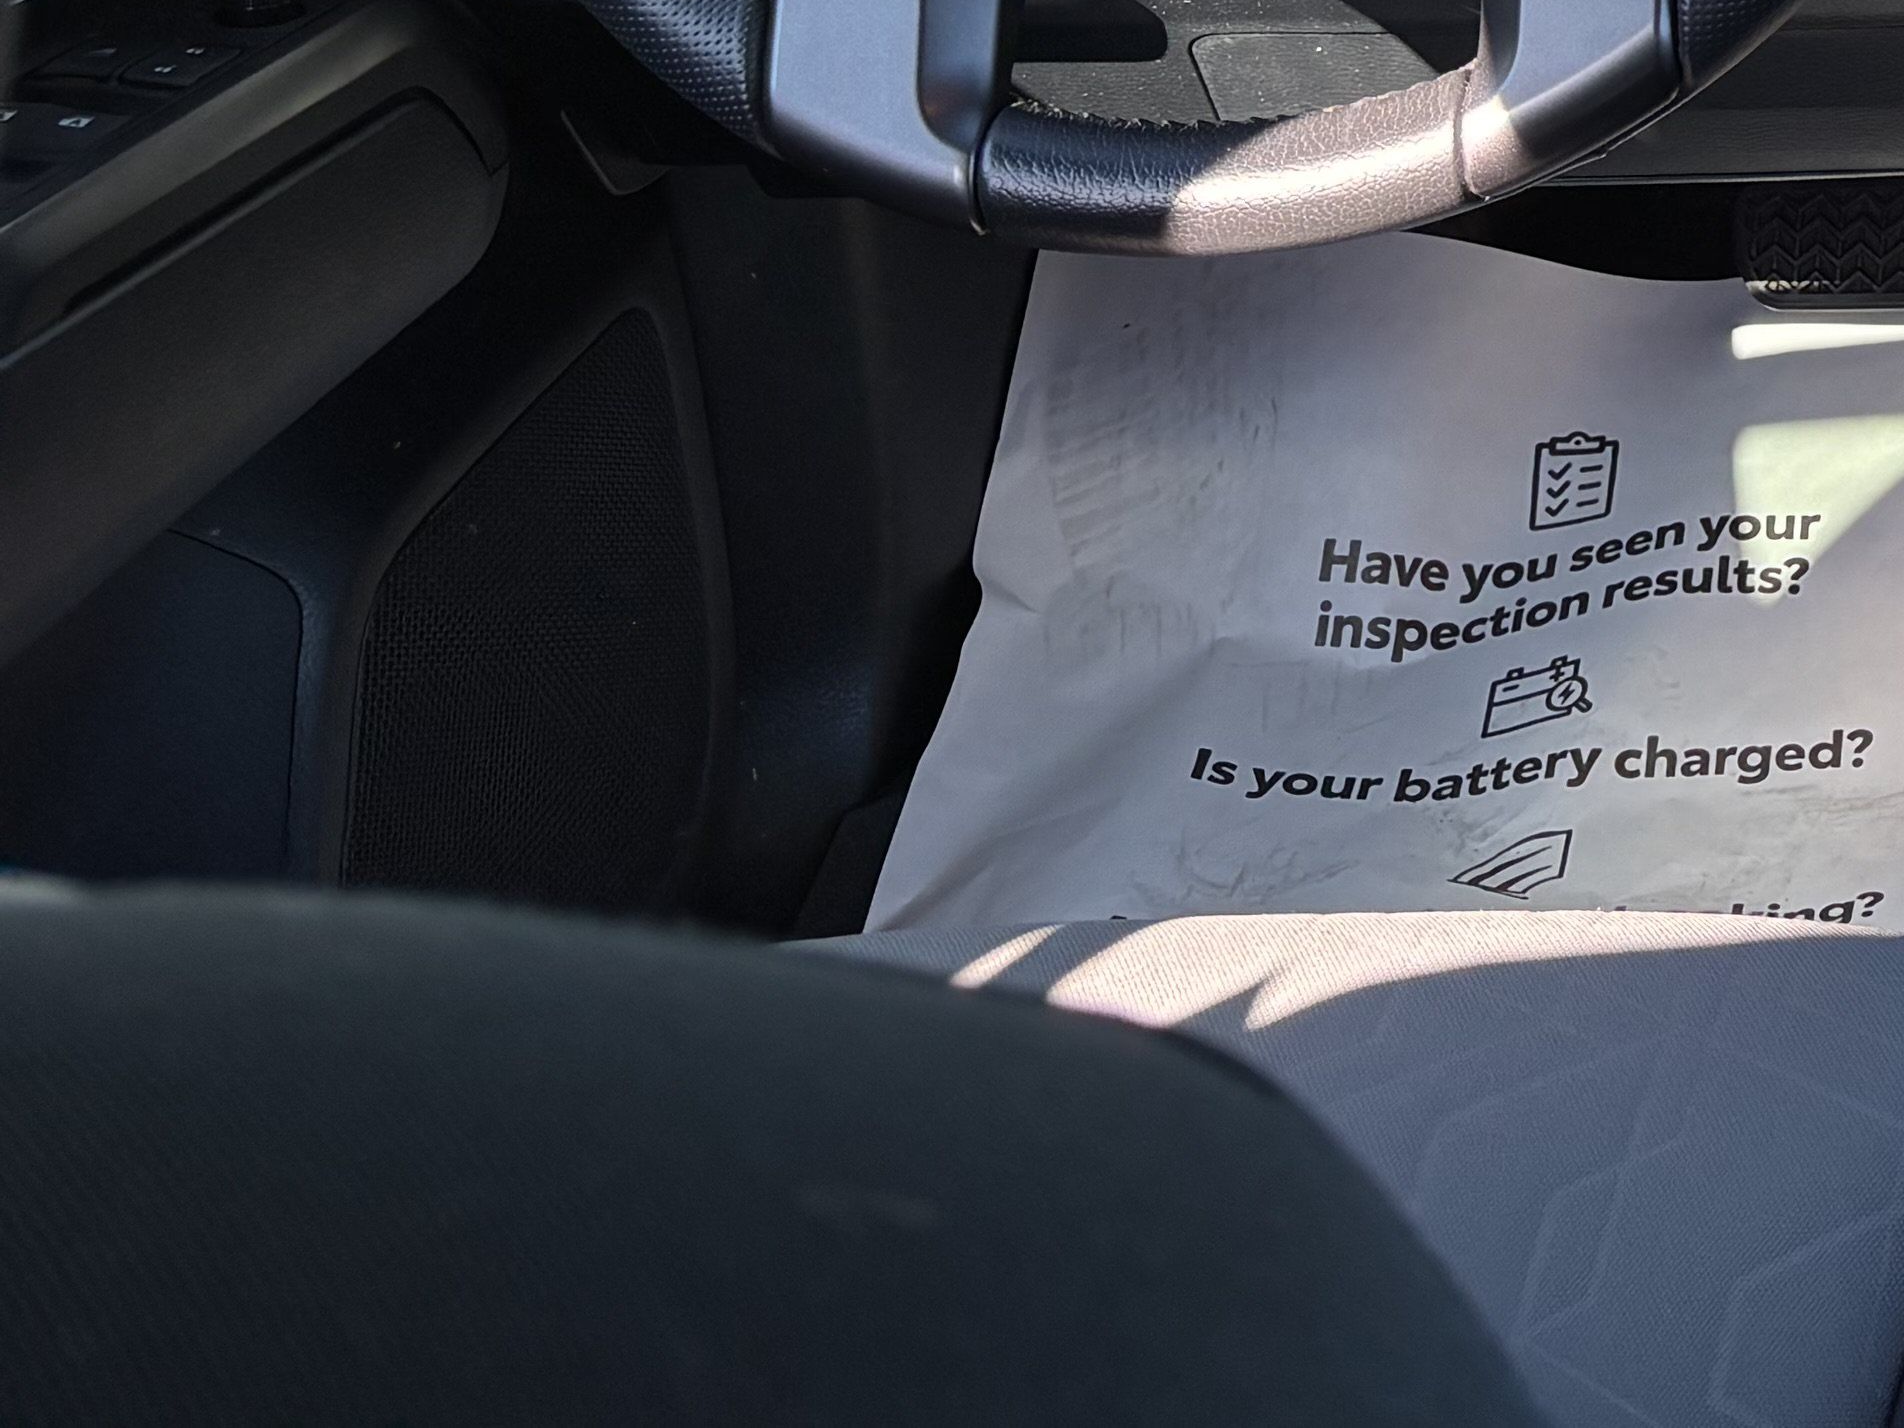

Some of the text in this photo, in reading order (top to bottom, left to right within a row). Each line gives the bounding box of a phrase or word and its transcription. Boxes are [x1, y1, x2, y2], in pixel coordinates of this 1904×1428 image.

[1316, 505, 1821, 603] Have you seen your
[1312, 555, 1811, 663] inspection results?
[1189, 728, 1875, 805] Is your battery charged?
